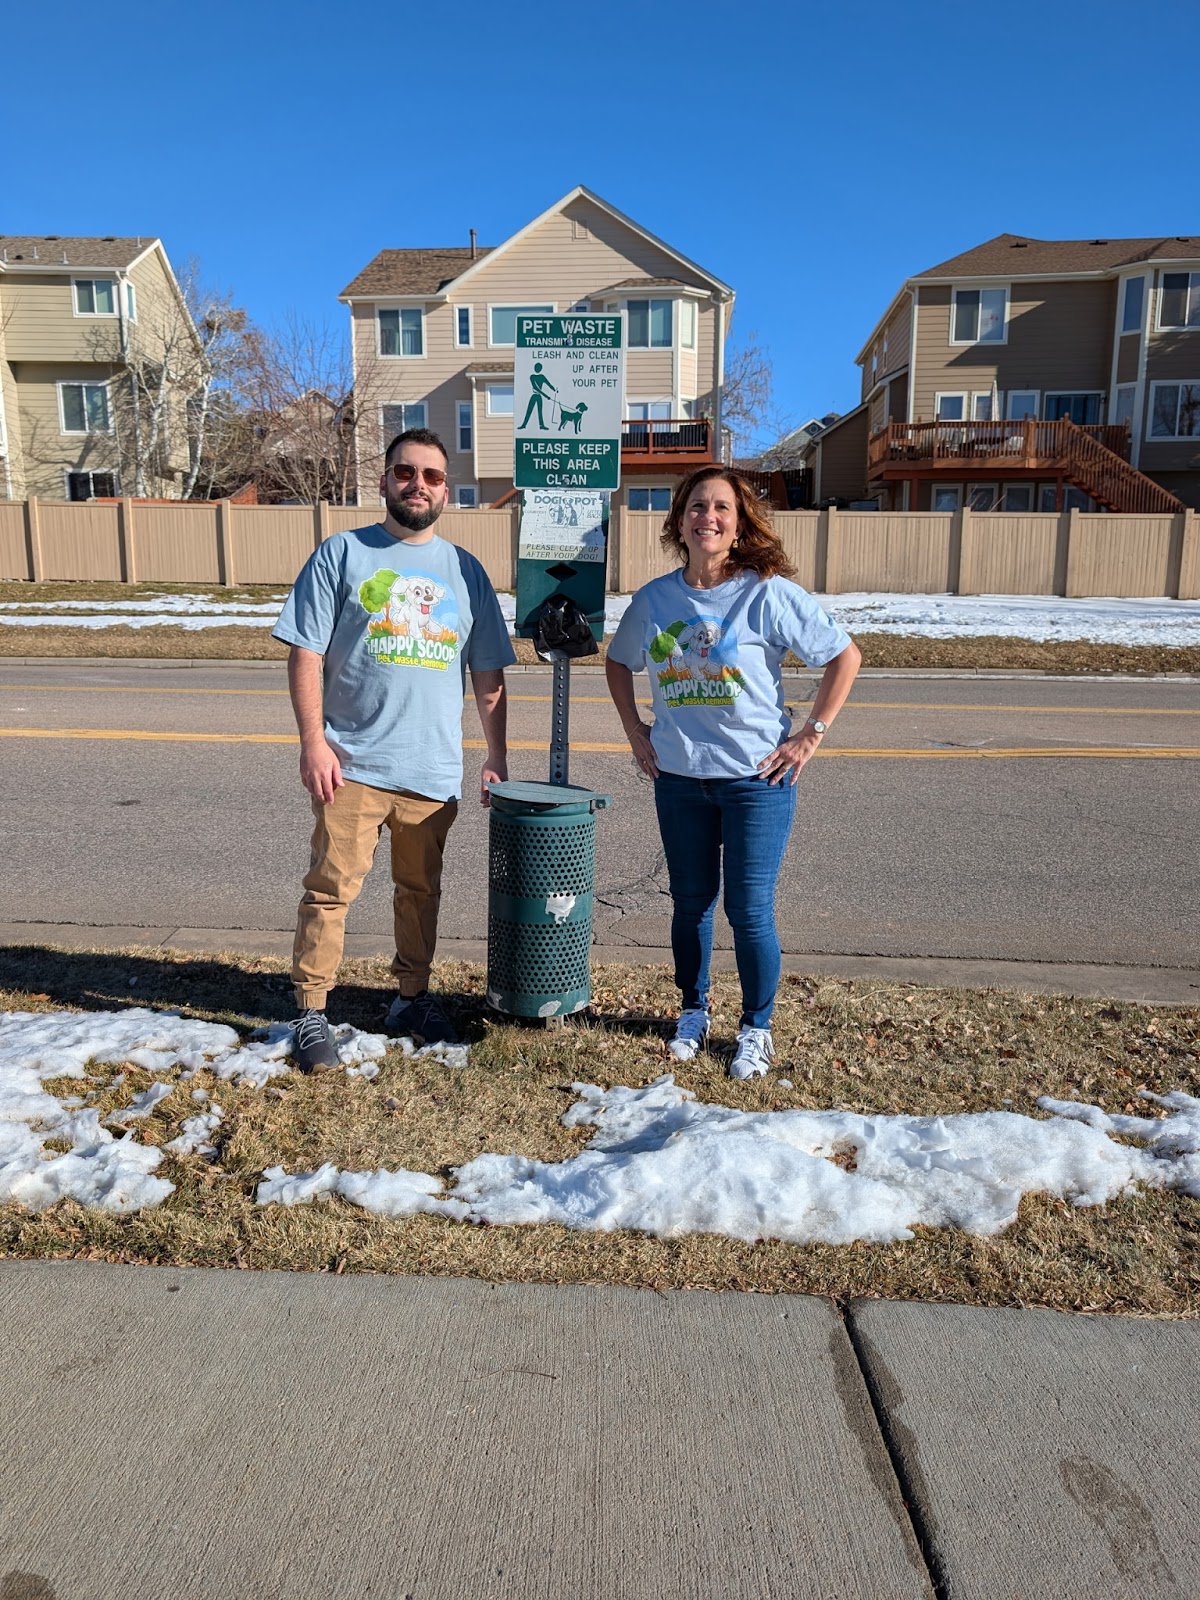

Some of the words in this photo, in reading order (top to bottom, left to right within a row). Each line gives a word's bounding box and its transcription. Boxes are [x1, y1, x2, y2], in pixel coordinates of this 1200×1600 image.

[522, 320, 553, 334] PET
[560, 320, 615, 334] WASTE
[576, 338, 612, 346] DISEASE
[532, 351, 560, 359] LEASH
[566, 351, 584, 360] AND
[588, 351, 619, 360] CLEAN
[572, 365, 584, 374] UP
[589, 365, 618, 374] AFTER
[572, 379, 596, 388] YOUR
[601, 379, 618, 388] PET
[522, 442, 570, 454] PLEASE
[578, 444, 610, 455] KEEP
[533, 458, 560, 470] THIS
[567, 459, 600, 470] AREA
[370, 636, 414, 656] HAPPY
[417, 640, 456, 662] SCOOP
[660, 680, 698, 700] HAPPY
[701, 680, 742, 698] SCOOP
